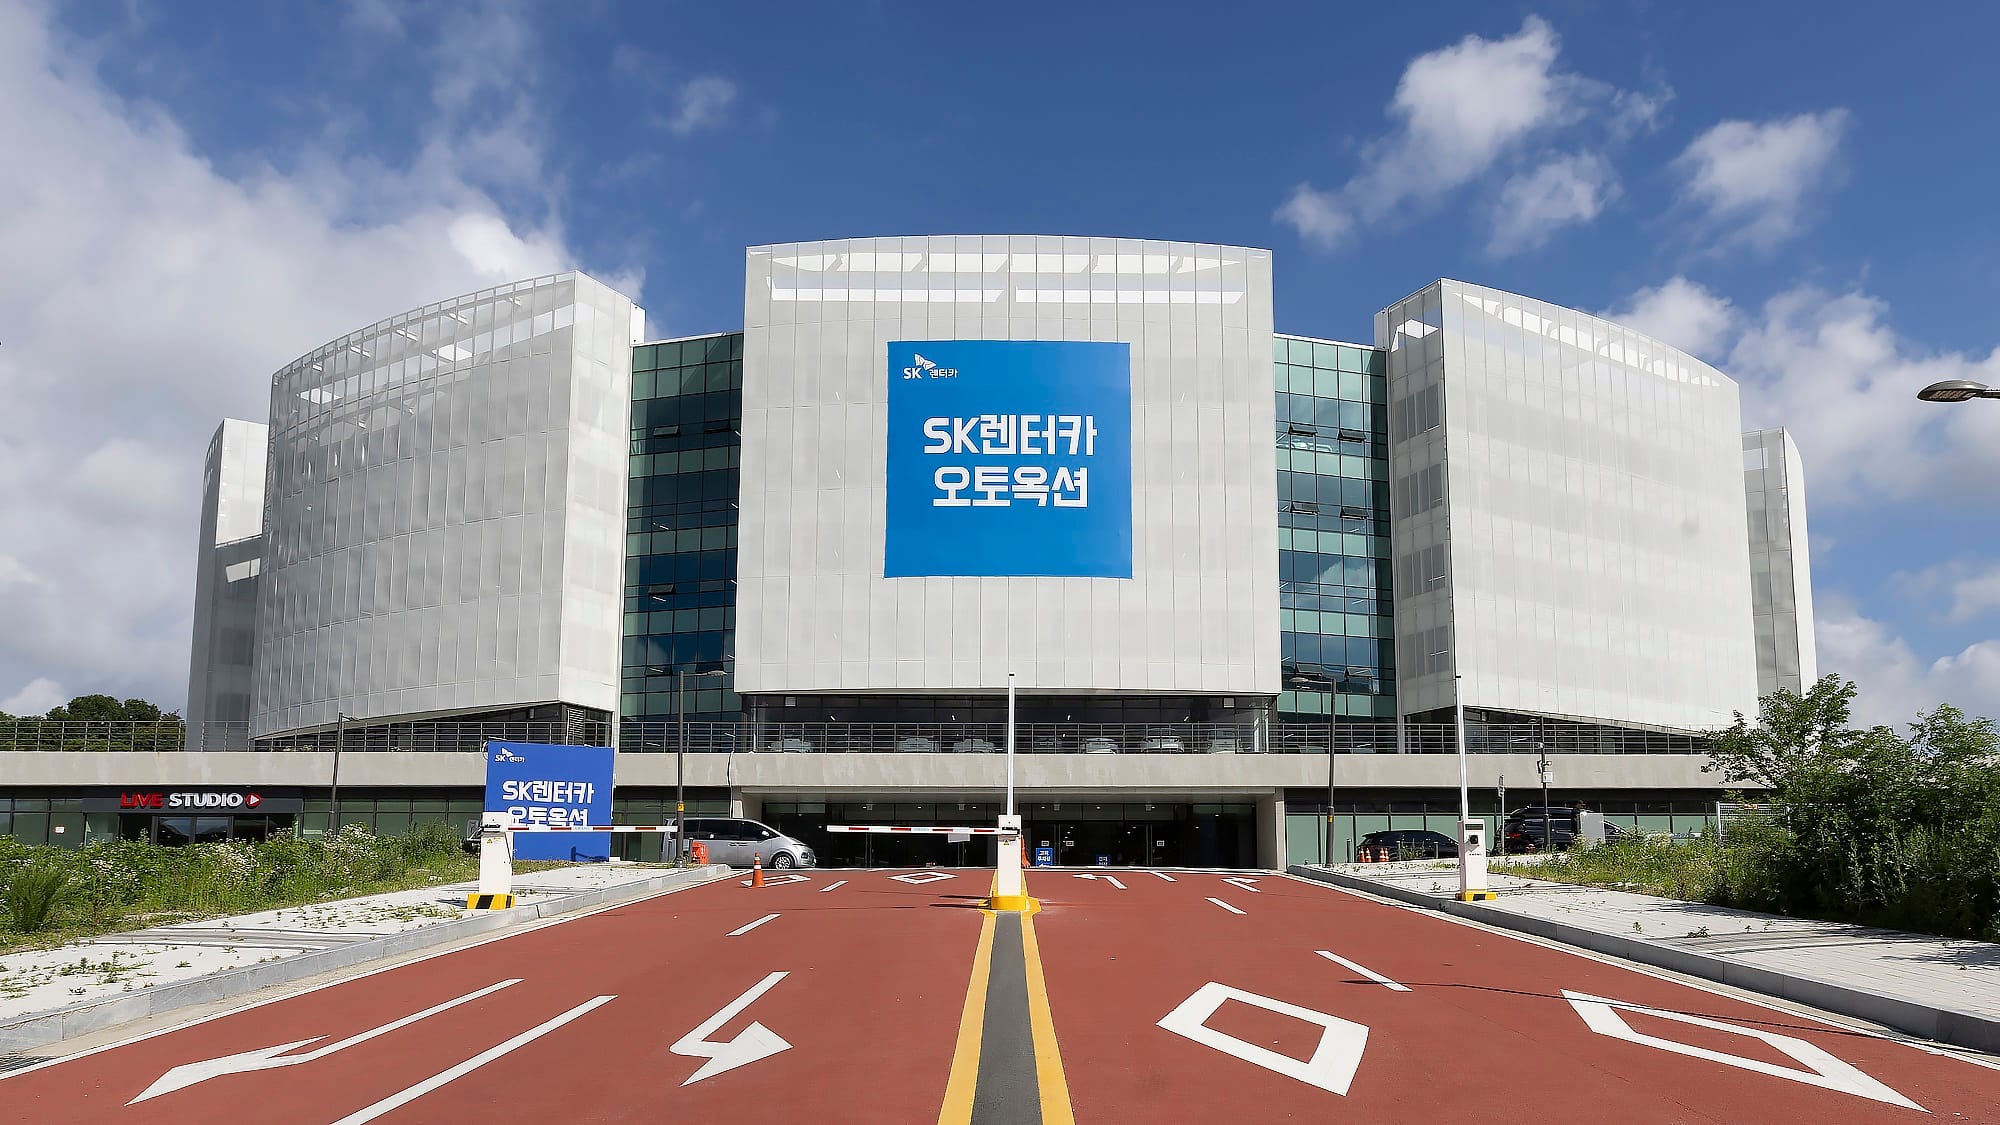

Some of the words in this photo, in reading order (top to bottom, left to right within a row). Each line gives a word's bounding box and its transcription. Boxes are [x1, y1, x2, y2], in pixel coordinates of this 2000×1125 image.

[923, 414, 1098, 456] SK렌터카
[932, 466, 1088, 508] 오토옥션
[120, 793, 163, 807] LIVE
[169, 793, 244, 807] STUDIO
[502, 780, 594, 804] SK렌터카
